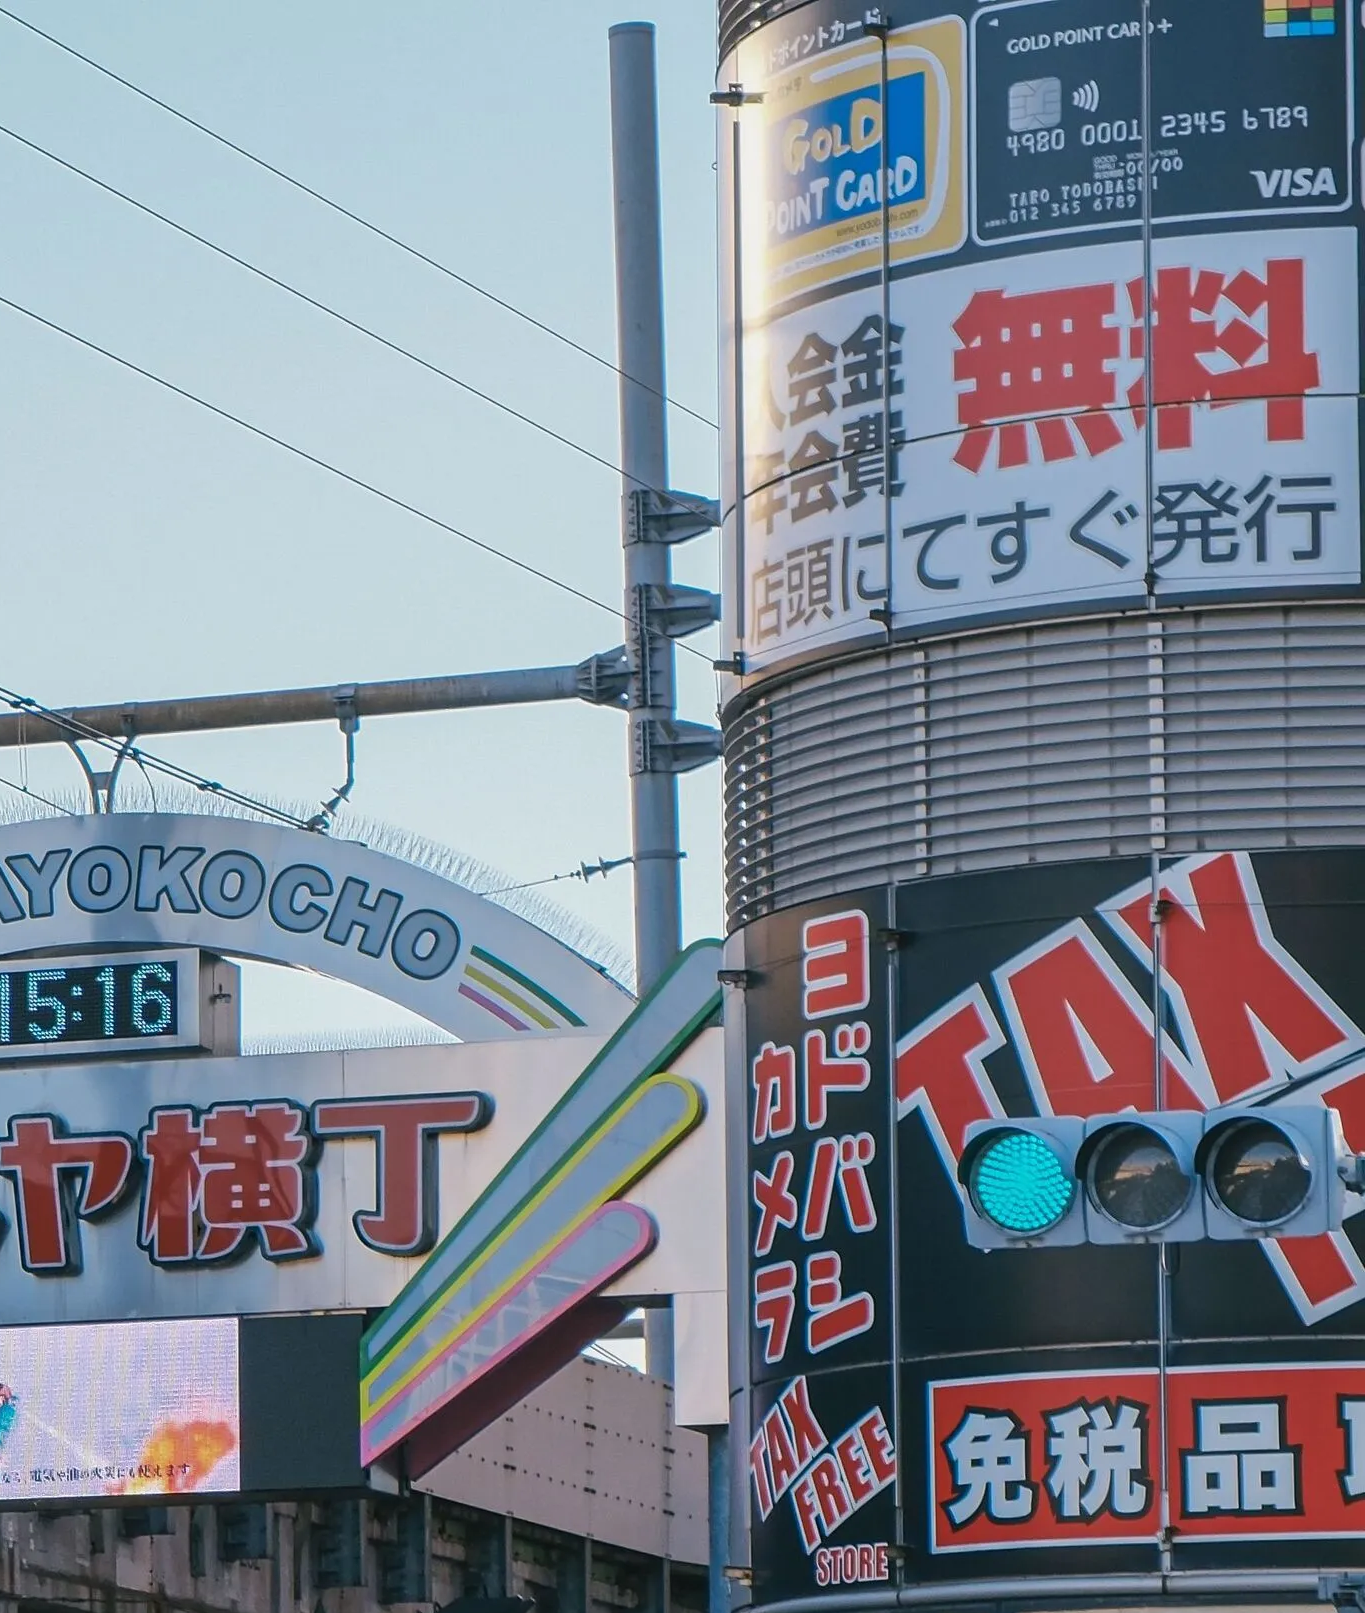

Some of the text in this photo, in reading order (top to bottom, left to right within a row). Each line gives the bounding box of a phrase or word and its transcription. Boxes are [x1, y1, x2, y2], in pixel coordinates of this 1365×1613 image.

[1007, 34, 1051, 55] GOLD
[1053, 26, 1104, 48] POINT
[782, 98, 883, 175] GOLD
[1007, 105, 1309, 157] 4980 0001 2345 6789
[835, 155, 918, 212] CARD
[1009, 208, 1040, 225] 012
[1051, 199, 1082, 217] 345
[1093, 194, 1138, 212] 6789
[1010, 188, 1050, 209] TARO
[1249, 167, 1338, 199] VISA
[951, 257, 1322, 475] 無料
[752, 410, 907, 536] 年会費
[749, 474, 1338, 646] 店頭にてすぐ発行
[895, 851, 1364, 1253] TAX
[800, 907, 878, 1355] ヨドバシ
[751, 1039, 797, 1364] カメラ
[749, 1374, 829, 1522] TAX
[790, 1405, 898, 1555] FREE
[815, 1542, 891, 1587] STORE
